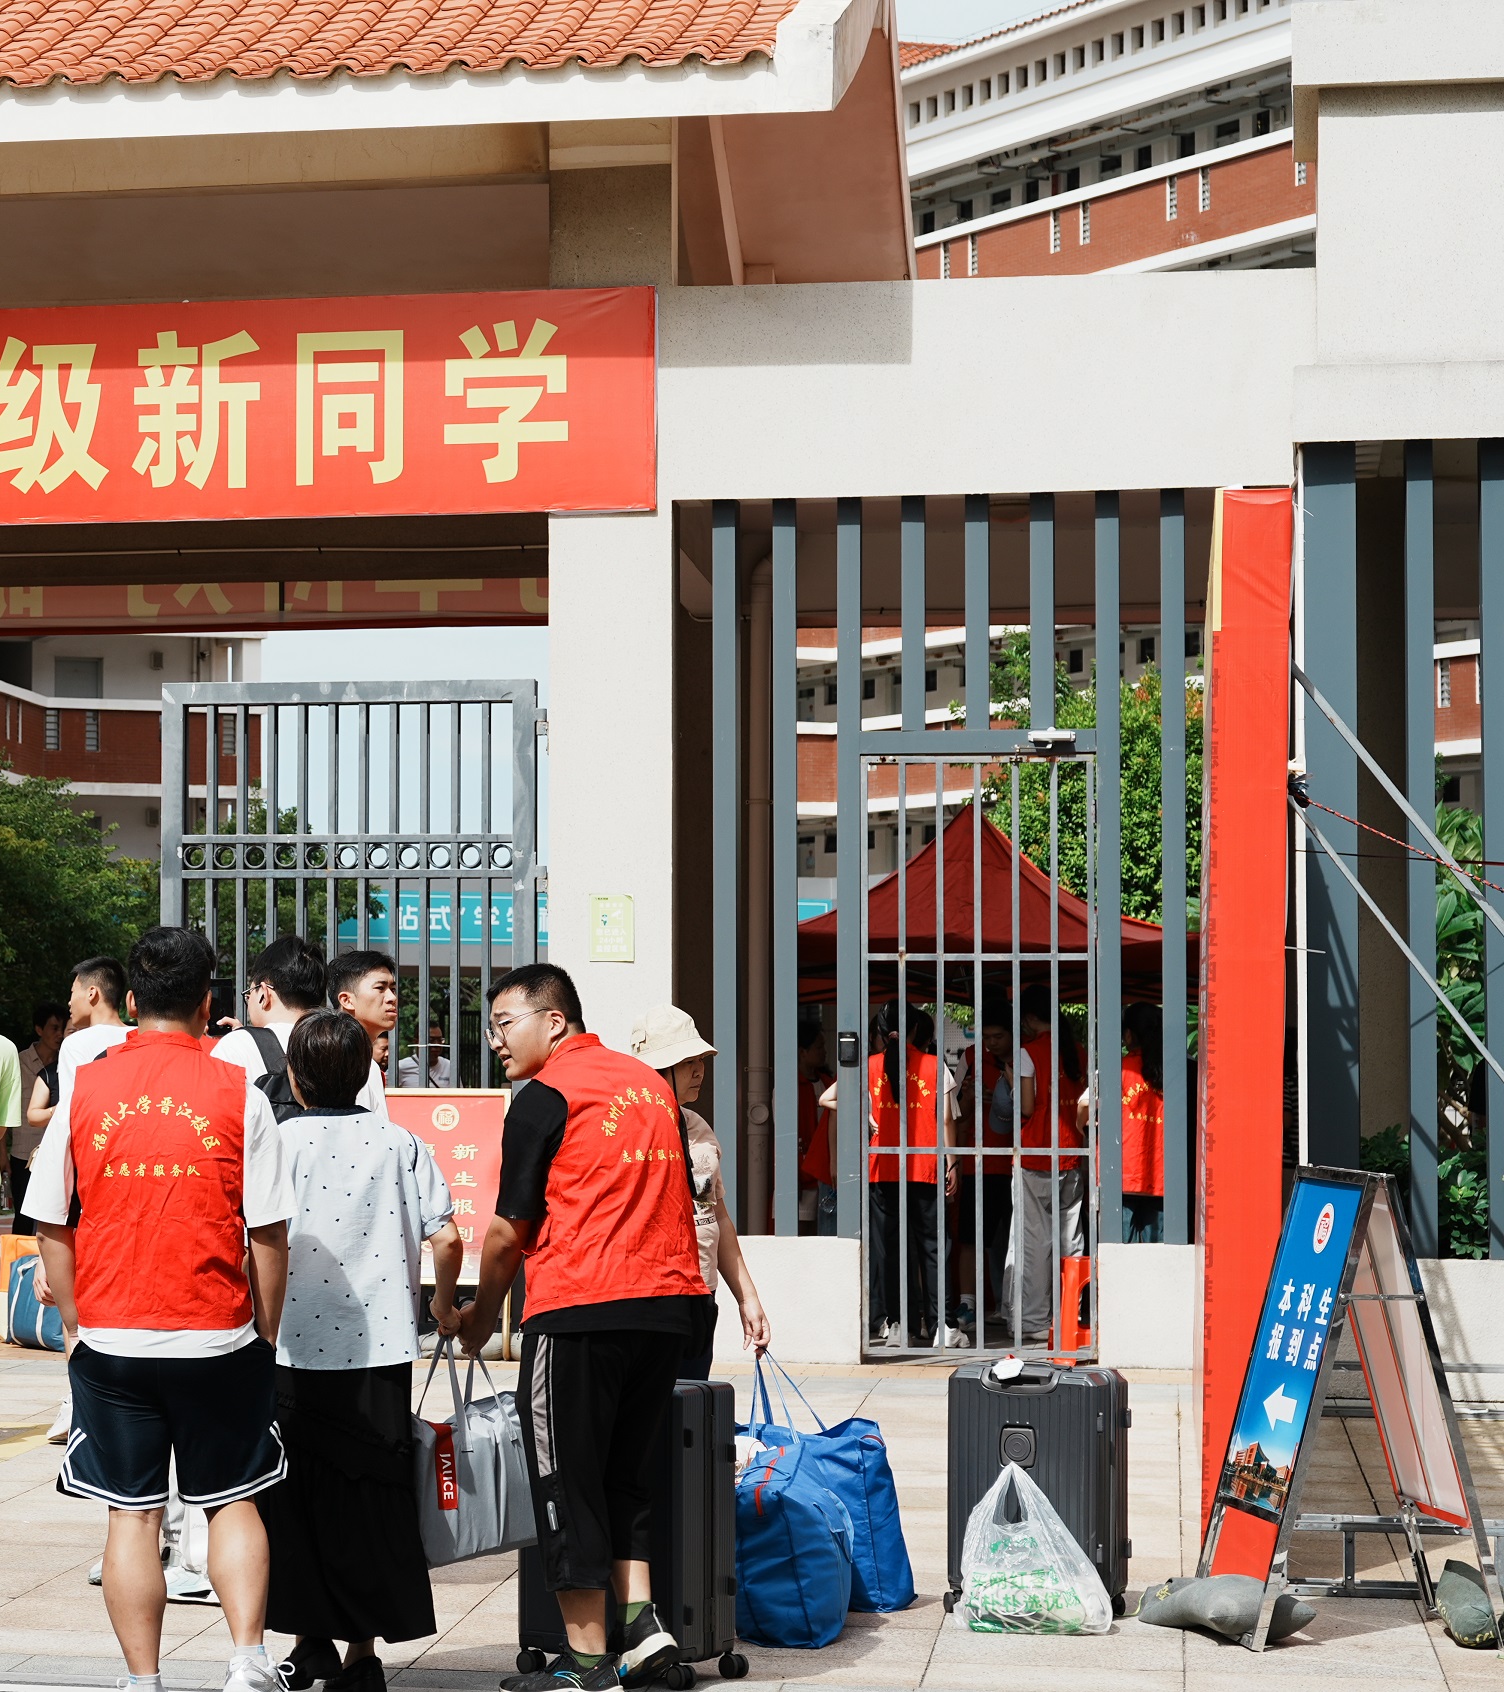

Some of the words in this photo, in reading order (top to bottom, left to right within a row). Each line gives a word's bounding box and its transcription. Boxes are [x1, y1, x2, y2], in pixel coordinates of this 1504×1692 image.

[92, 1094, 221, 1151] 福州大学晋江校区
[103, 1162, 201, 1178] 志愿者服务队
[1277, 1278, 1333, 1326] 本科生
[1266, 1322, 1323, 1372] 报到点
